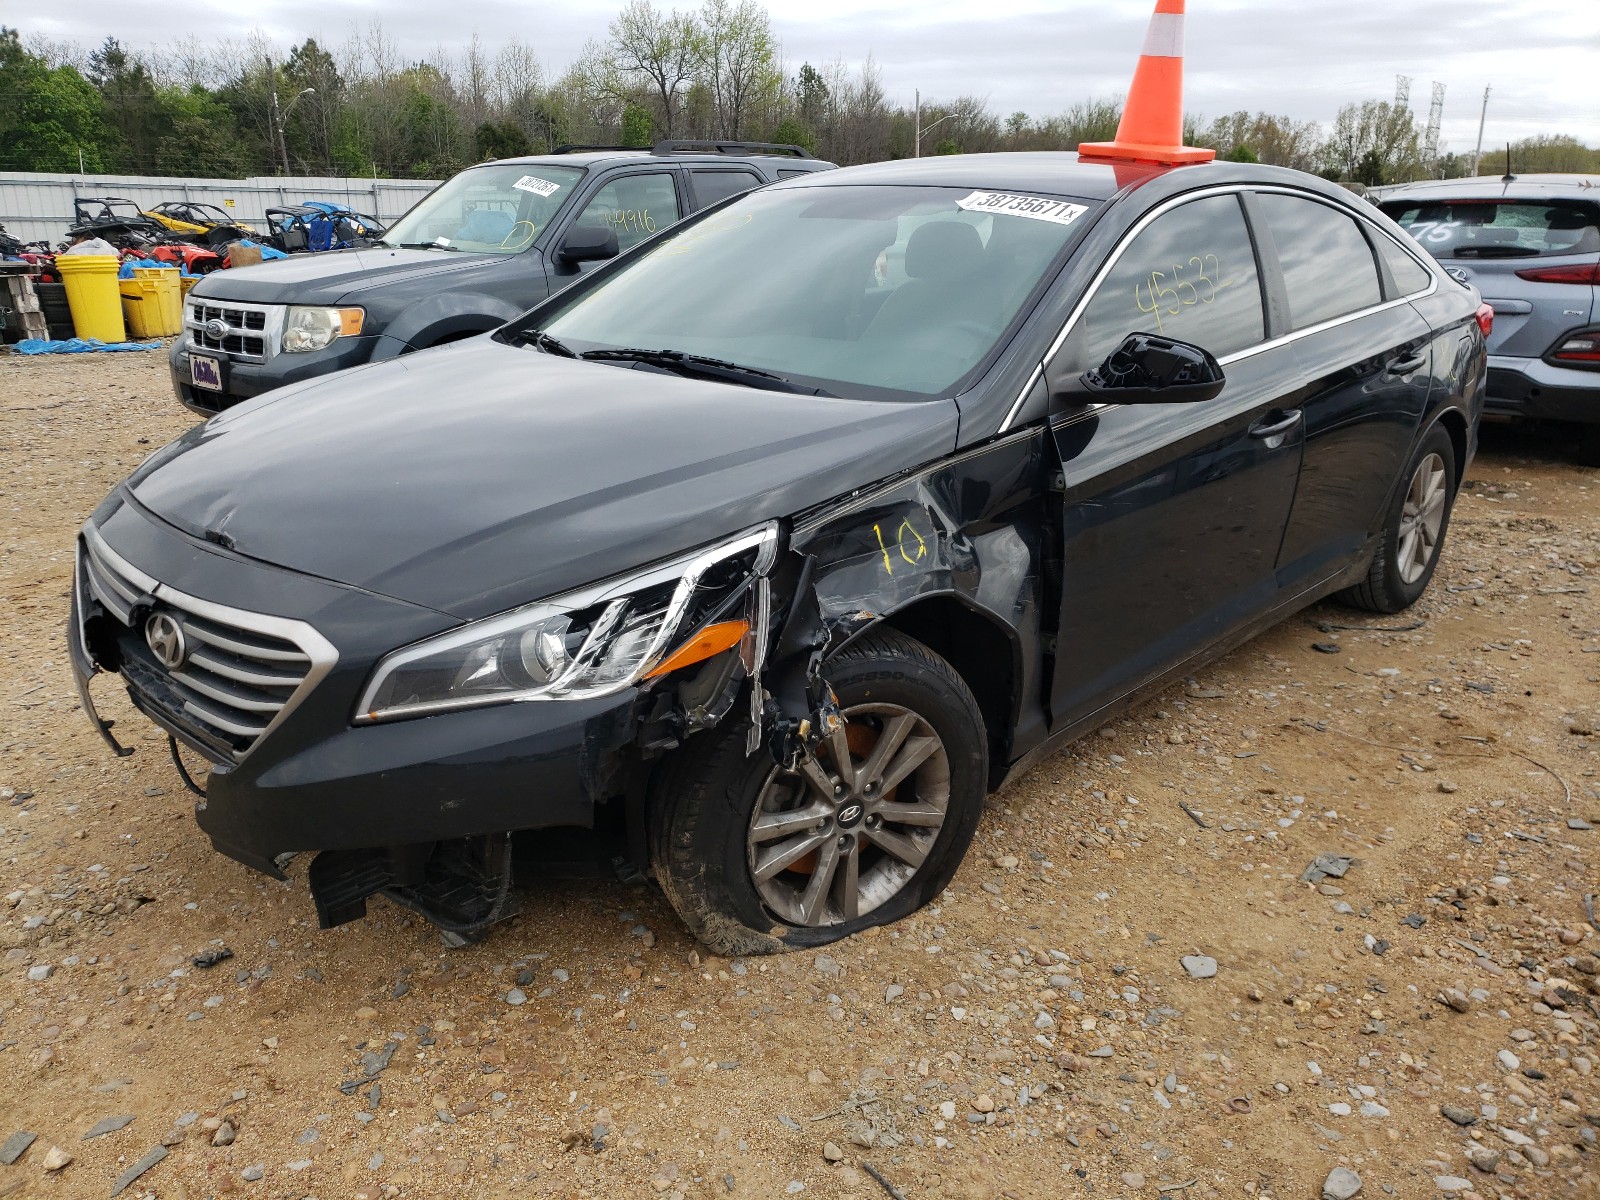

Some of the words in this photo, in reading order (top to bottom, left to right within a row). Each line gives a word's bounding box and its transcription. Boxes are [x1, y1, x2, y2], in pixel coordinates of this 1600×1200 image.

[1409, 221, 1461, 242] 75
[1135, 254, 1233, 335] 45532
[873, 517, 927, 576] 10
